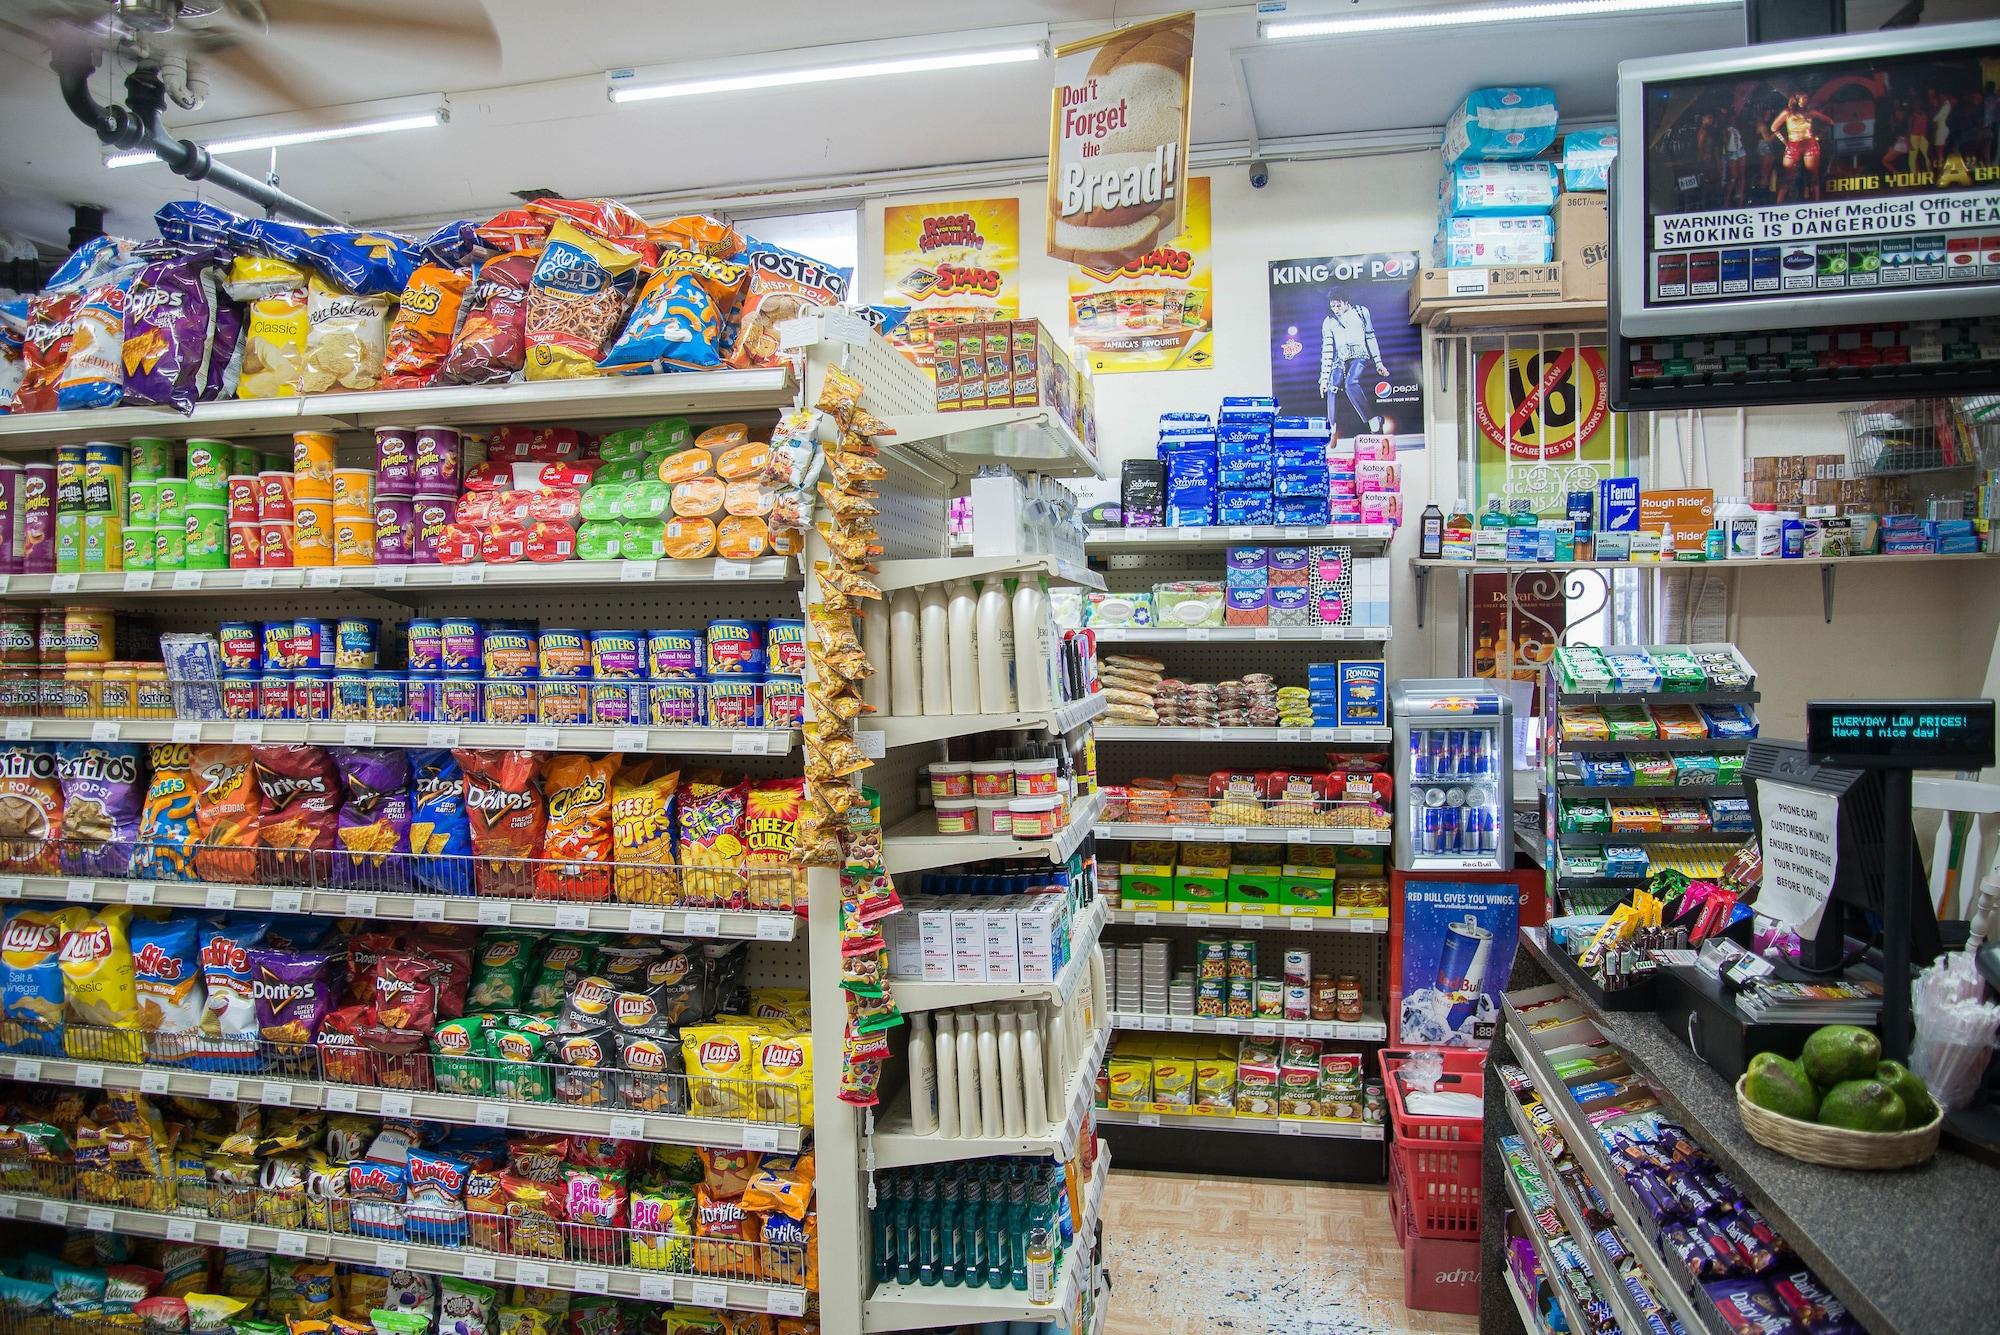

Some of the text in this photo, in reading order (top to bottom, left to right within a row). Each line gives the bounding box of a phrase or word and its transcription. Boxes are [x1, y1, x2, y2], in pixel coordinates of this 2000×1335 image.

[1062, 79, 1098, 107] Don't
[1065, 98, 1128, 138] Forget
[1083, 142, 1100, 157] the
[1062, 142, 1177, 217] Bread!
[1825, 176, 1879, 192] BRING
[1885, 171, 1933, 188] YOUR
[1663, 197, 1980, 230] WARNING: The Chief Medical Officer
[923, 214, 976, 237] Reach
[1663, 209, 2000, 244] SMOKING IS DANGEROUS TO HEA
[538, 261, 601, 290] GOLD
[936, 263, 1000, 291] STARS
[1273, 259, 1415, 285] KING OF POP
[254, 321, 297, 335] Classic
[1104, 337, 1180, 348] JAMAICA'S FAVOURITE
[1392, 384, 1418, 394] pepsi
[1519, 367, 1562, 417] IT'S LAW
[1229, 431, 1259, 442] Stayfree
[1477, 406, 1494, 431] DON'T
[1510, 442, 1559, 456] CIGARETES
[1560, 441, 1573, 451] TO
[381, 453, 408, 471] Pringles
[1363, 464, 1385, 472] Kotex
[189, 465, 216, 480] Pringles
[388, 467, 407, 476] BBQ
[421, 467, 437, 476] BBQ
[1173, 476, 1208, 489] Stayfree
[1365, 494, 1387, 502] Kotex
[1610, 484, 1636, 500] Ferrol
[1229, 497, 1260, 508] Stayfree
[1642, 498, 1704, 508] Rough Rider
[1677, 532, 1704, 540] Rider
[484, 636, 527, 651] PLANTERS
[539, 634, 580, 650] PLANTERS
[714, 643, 739, 651] Cocktail
[1346, 668, 1380, 679] RONZONI
[1832, 715, 1968, 727] EVERYDAY LOW PRICES!
[1832, 728, 1859, 737] Have
[1879, 728, 1906, 737] nice
[1913, 728, 1939, 739] day!
[1635, 761, 1668, 769] Extra
[1231, 783, 1252, 792] MEIN
[1289, 783, 1309, 792] MEIN
[1348, 782, 1368, 791] MEIN
[1679, 775, 1715, 786] Extra
[9, 782, 57, 811] ROUNDS
[1568, 806, 1603, 816] eclipse
[1619, 809, 1652, 817] Orbit
[1778, 803, 1817, 820] PHONE CARD
[510, 821, 534, 829] CHEESE
[511, 815, 534, 823] NACHO
[1771, 820, 1829, 844] CUSTOMERS KINDLY
[749, 833, 796, 851] CURLS
[1769, 838, 1831, 866] ENSURE YOU RECEIVE
[1773, 857, 1791, 872] YOUR
[1792, 863, 1813, 878] PHONE
[1777, 876, 1800, 892] BEFORE
[1408, 892, 1515, 905] RED BULL GIVES YOU WINGS.
[9, 973, 33, 983] Salt &
[1461, 979, 1481, 992] Bull
[7, 982, 39, 995] Vinegar
[253, 981, 315, 999] Doritos
[570, 1012, 606, 1026] Barbecue
[627, 1048, 664, 1066] Lay's
[703, 1042, 738, 1062] Lay's
[765, 1045, 801, 1065] Lay's
[411, 1155, 464, 1190] Ruffles
[350, 1167, 401, 1196] Ruffles
[468, 1174, 497, 1189] Party
[469, 1185, 491, 1197] Mix
[1788, 1272, 1838, 1324] Dairy Milk
[1729, 1292, 1759, 1324] Dairy
